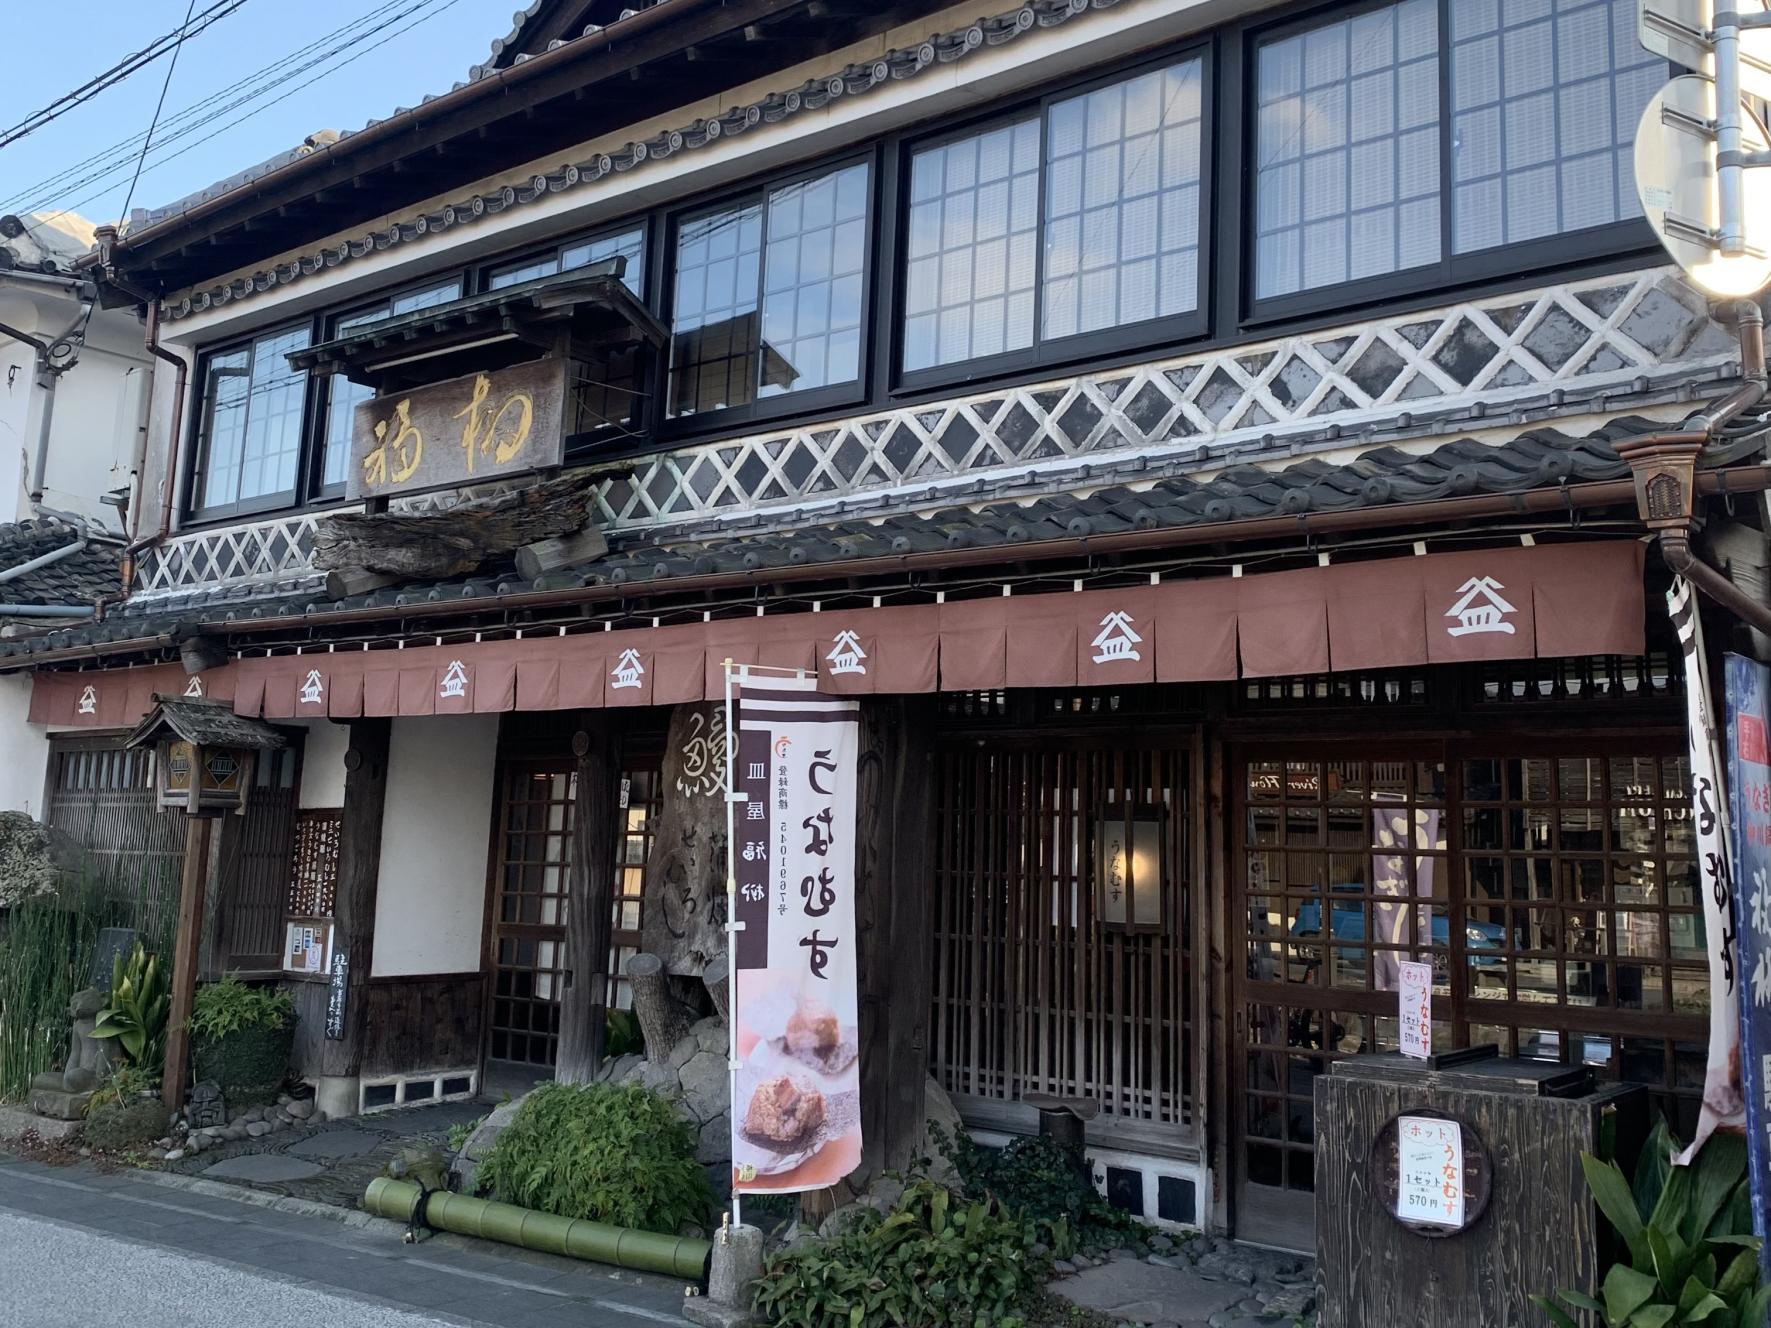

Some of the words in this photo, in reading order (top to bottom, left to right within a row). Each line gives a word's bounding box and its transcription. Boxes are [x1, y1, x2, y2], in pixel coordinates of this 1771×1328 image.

[1109, 839, 1123, 904] うなむす
[1405, 969, 1425, 981] ホット
[1420, 987, 1430, 1053] うなむす
[1410, 1124, 1447, 1141] ホット
[1442, 1144, 1458, 1217] うなむす
